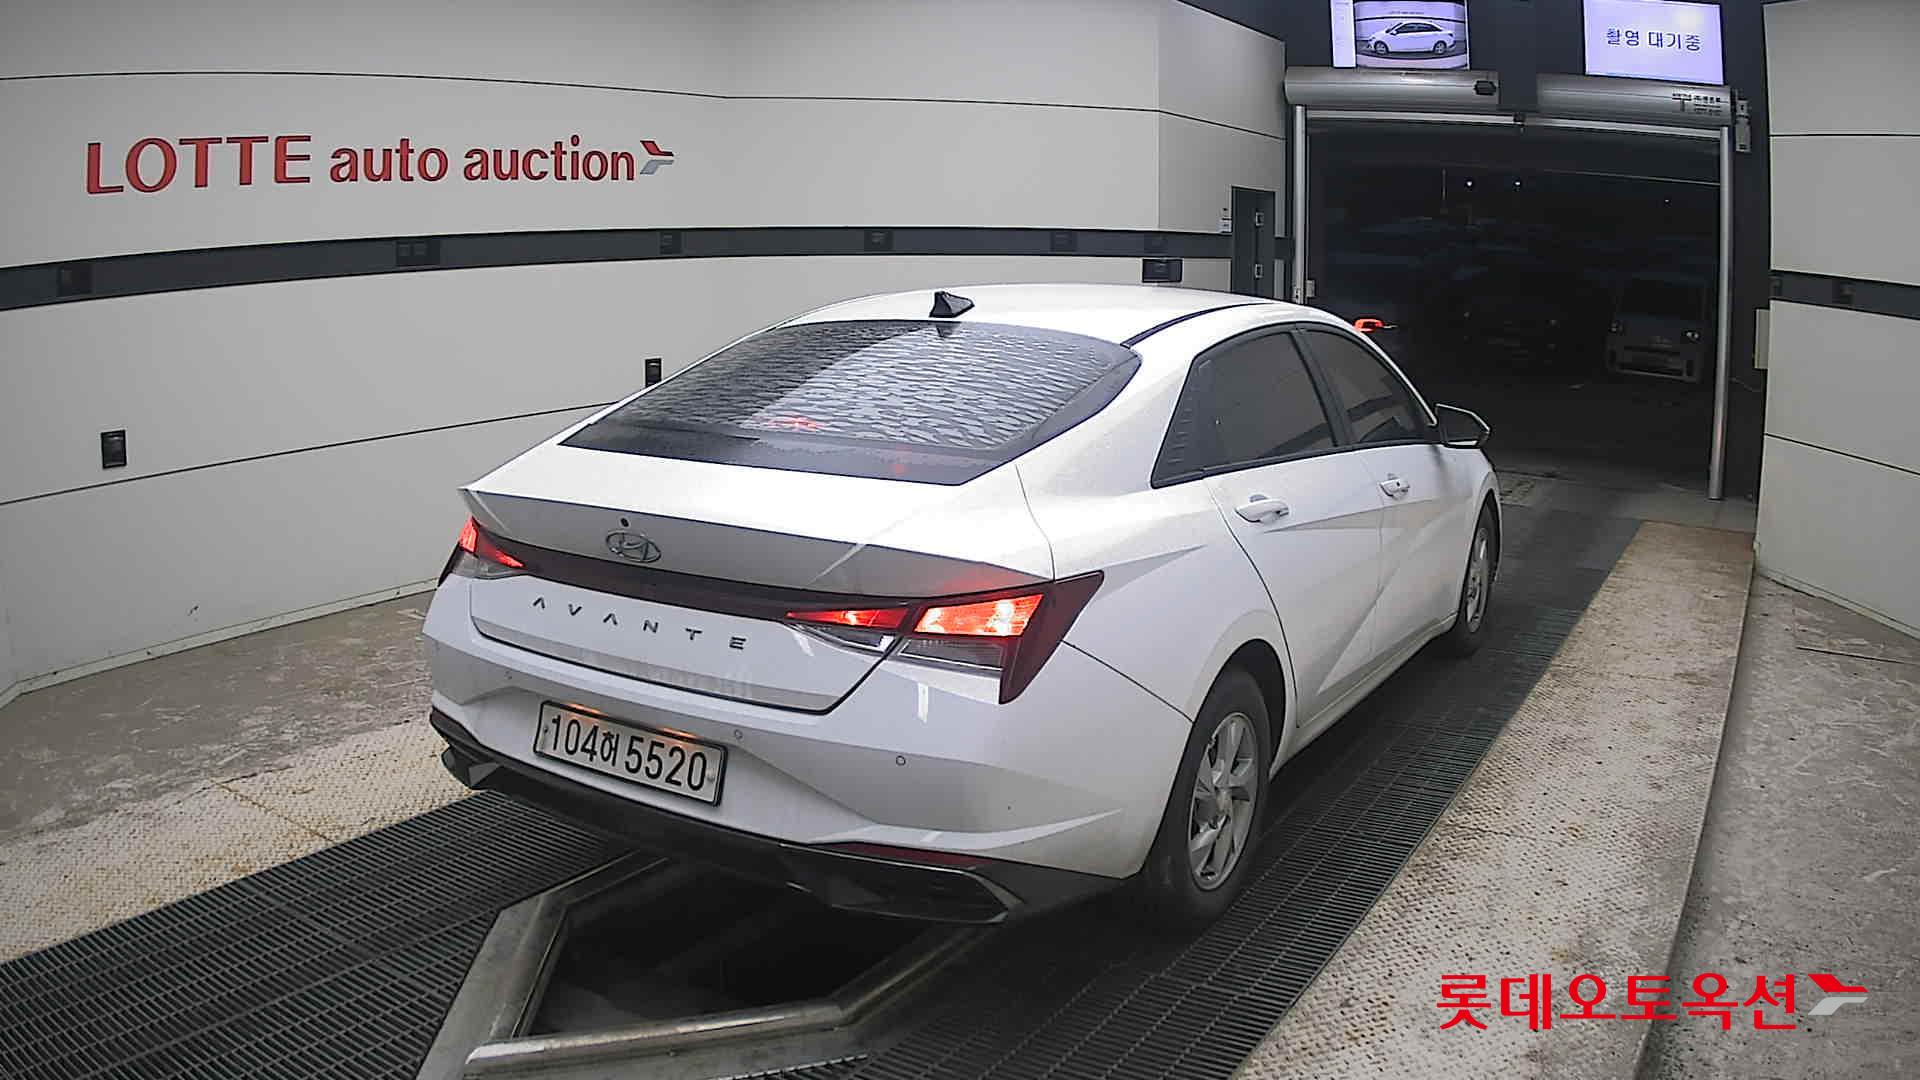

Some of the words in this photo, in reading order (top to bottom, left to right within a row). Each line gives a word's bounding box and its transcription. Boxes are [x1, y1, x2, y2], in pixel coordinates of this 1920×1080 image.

[1607, 28, 1640, 47] 촬영
[1648, 31, 1701, 52] 대기중
[86, 134, 312, 195] LOTTE
[329, 138, 449, 183] auto
[463, 134, 635, 182] auction
[532, 596, 747, 650] AVANTE
[551, 714, 620, 767] 104허
[624, 736, 708, 791] 5520
